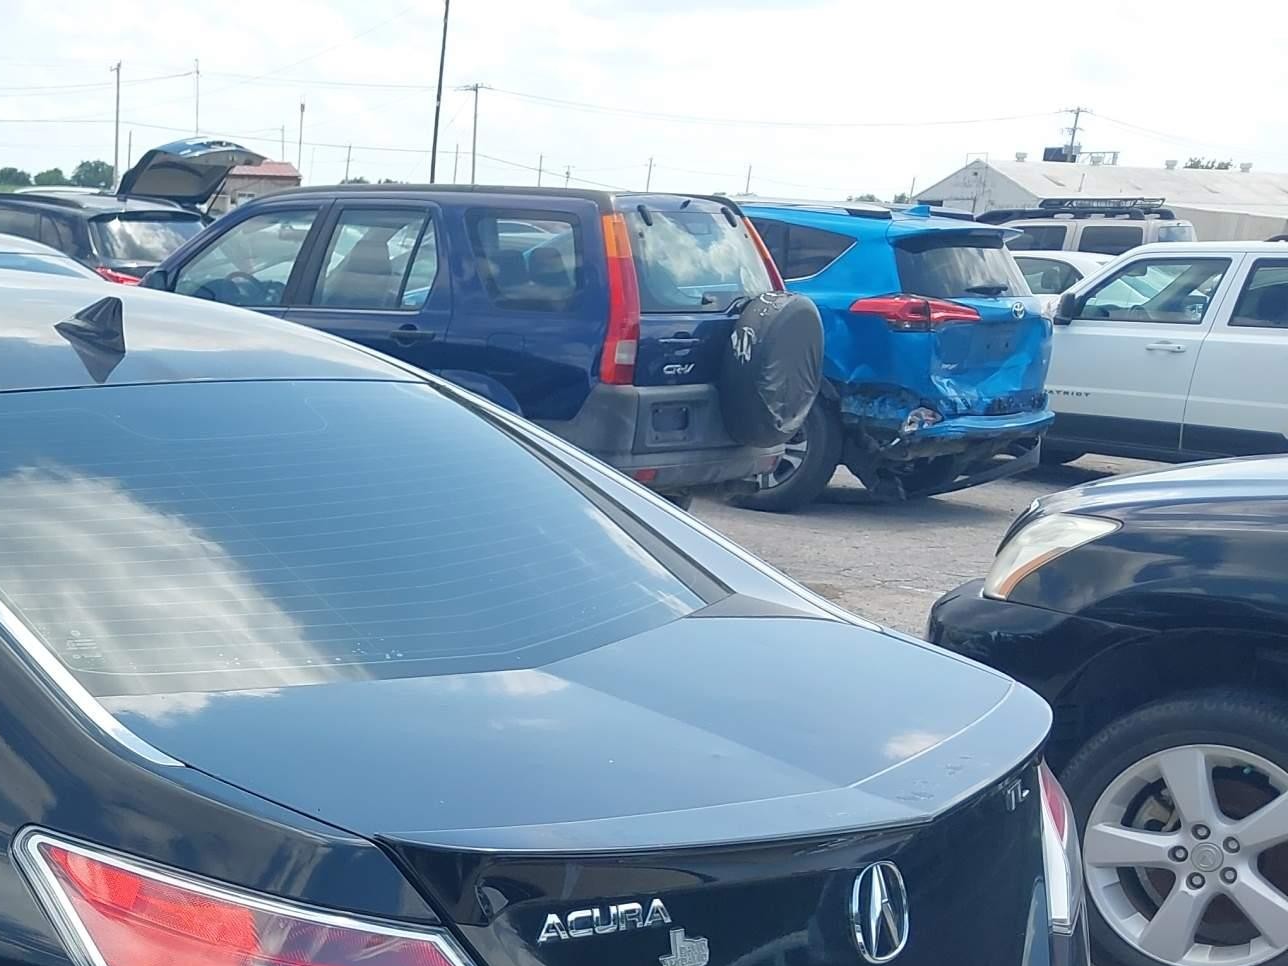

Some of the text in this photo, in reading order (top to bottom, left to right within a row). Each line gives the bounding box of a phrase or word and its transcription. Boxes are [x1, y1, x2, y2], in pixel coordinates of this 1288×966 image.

[1044, 389, 1091, 397] ATRIOT
[1007, 779, 1030, 811] TL
[537, 898, 672, 944] ACURA
